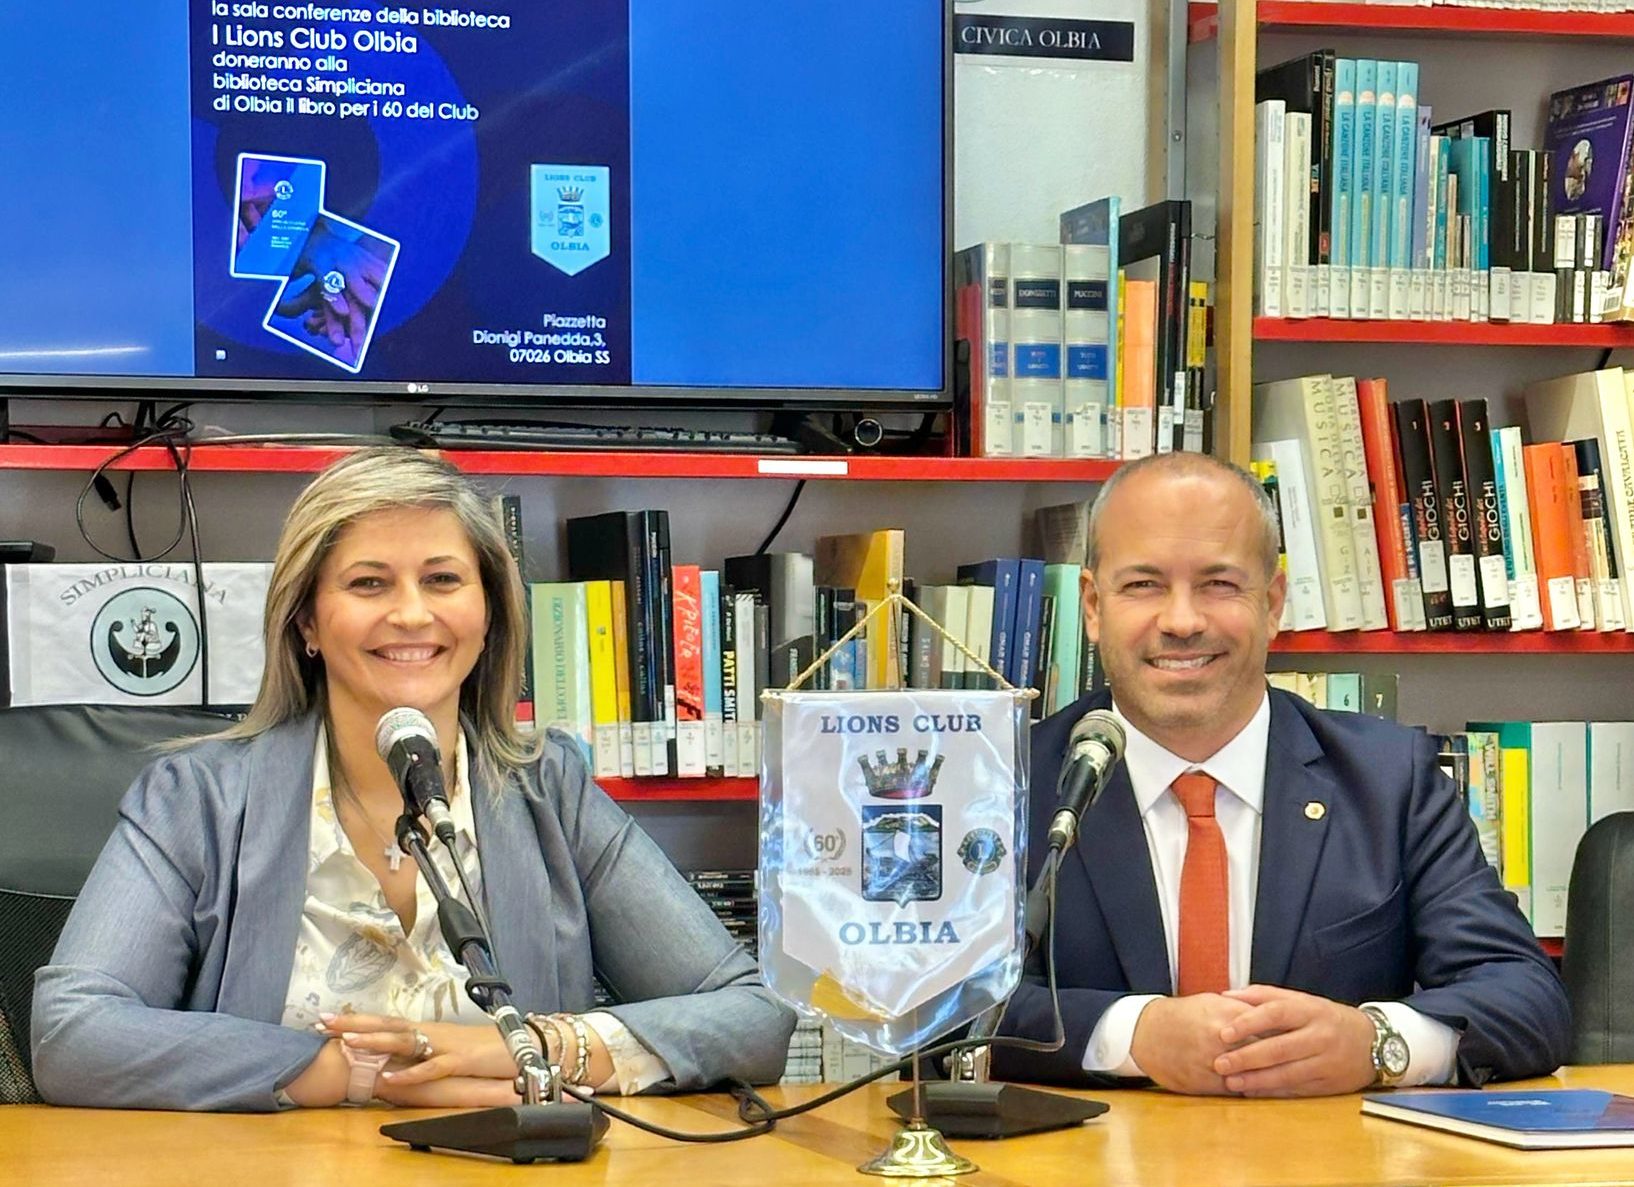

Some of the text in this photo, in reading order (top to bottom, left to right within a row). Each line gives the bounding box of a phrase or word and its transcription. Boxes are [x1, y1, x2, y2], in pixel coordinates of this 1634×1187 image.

[212, 0, 510, 28] la sala conferenze della biblioteca
[212, 24, 417, 53] I Lions Club Olbia
[961, 26, 1101, 49] CIVICA OLBIA
[212, 50, 348, 72] doneranno alla
[213, 72, 405, 97] biblioteca Simpliciana
[213, 94, 230, 111] di
[234, 95, 282, 113] Olbia
[298, 97, 336, 115] libro
[340, 101, 370, 119] per
[382, 101, 403, 118] 60
[406, 102, 434, 118] del
[438, 103, 479, 120] Club
[543, 314, 606, 328] Piazzetta
[473, 330, 521, 347] Dionigi
[509, 349, 610, 364] 07026 Olbia SS
[1311, 380, 1333, 477] MUSICA
[1335, 383, 1357, 479] MUSICA
[1422, 480, 1440, 540] GIOCHI
[1452, 480, 1470, 541] GIOCHI
[1483, 480, 1501, 541] GIOCHI
[60, 565, 228, 606] SIMPLICIANA
[1429, 615, 1452, 628] UTET
[1458, 616, 1480, 627] UTET
[1487, 616, 1511, 628] UTET
[723, 651, 735, 686] PATTI
[1344, 694, 1350, 706] 6
[1376, 693, 1383, 708] 7
[821, 714, 982, 734] LIONS CLUB
[839, 921, 960, 945] OLBIA
